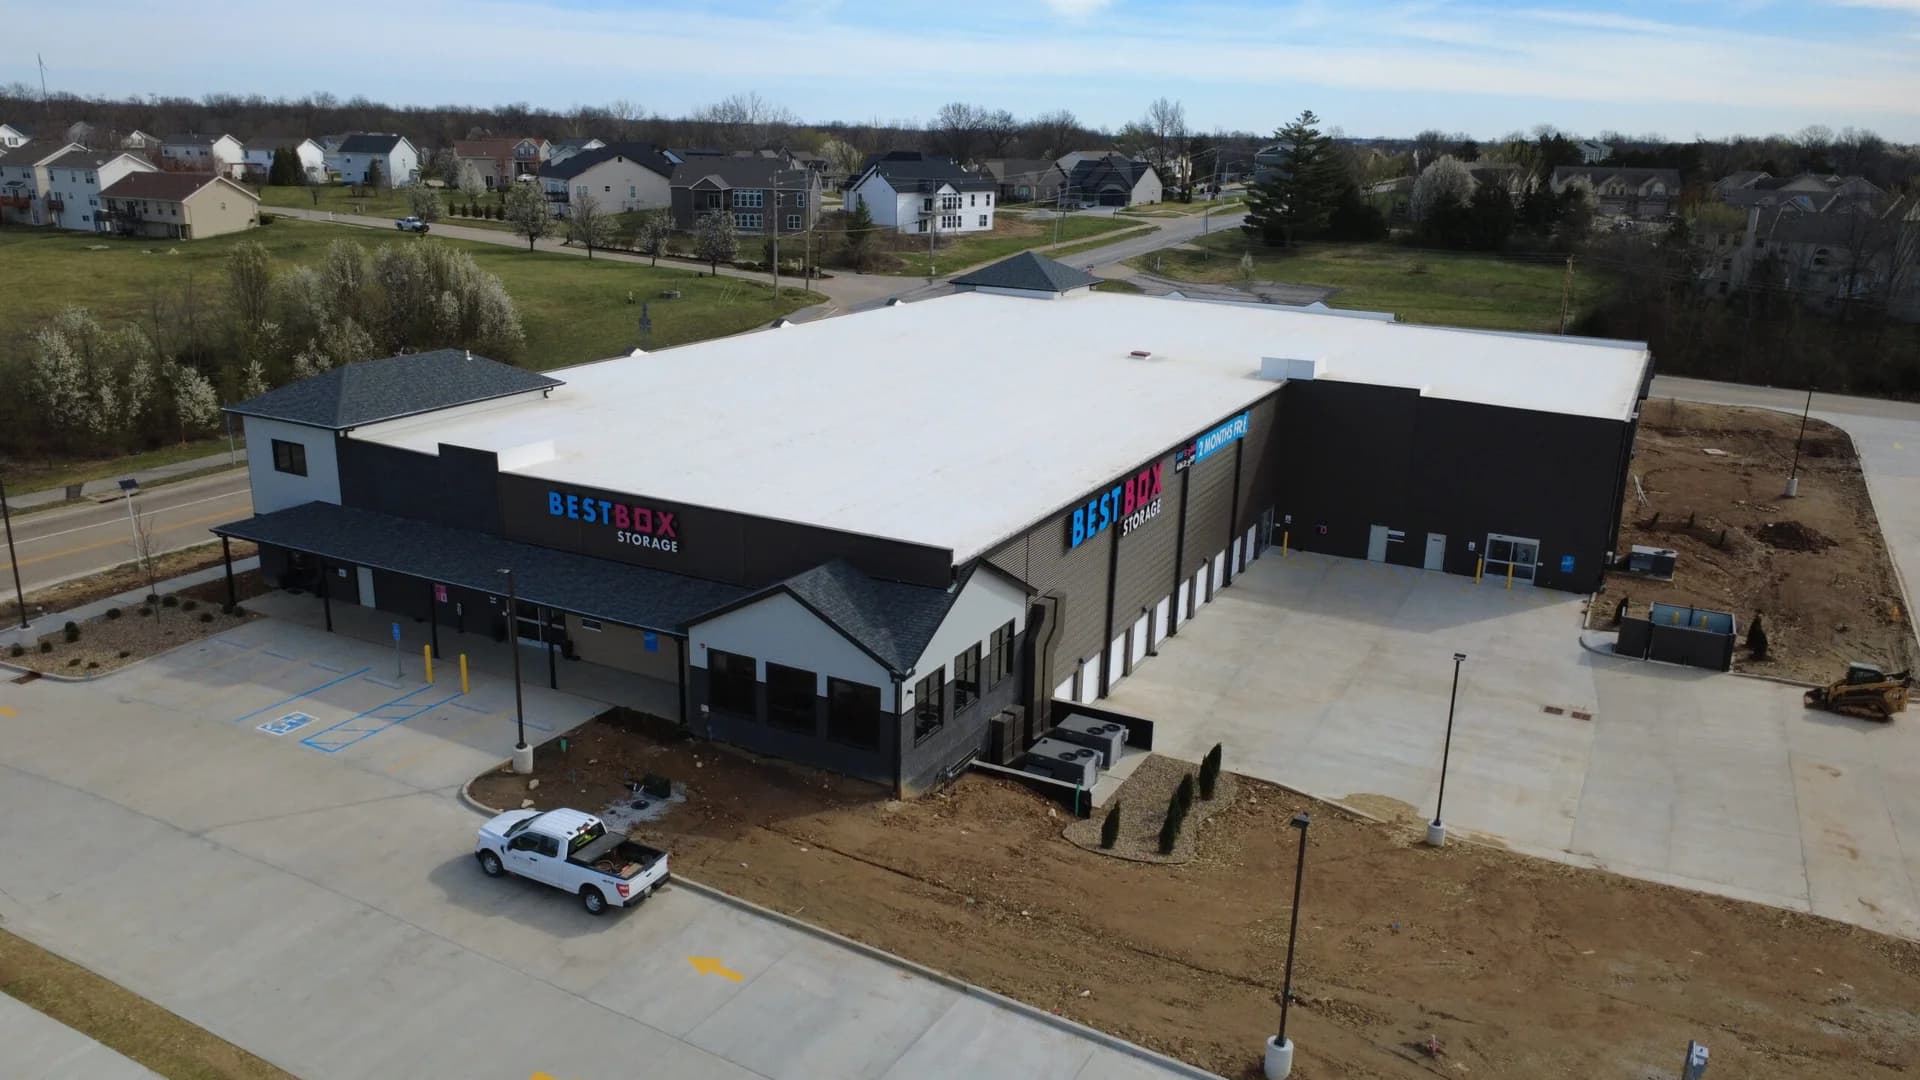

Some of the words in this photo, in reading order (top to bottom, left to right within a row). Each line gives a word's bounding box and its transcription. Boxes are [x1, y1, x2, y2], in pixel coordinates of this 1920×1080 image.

[1199, 441, 1204, 457] 2
[1204, 424, 1233, 454] MONTHS
[1123, 499, 1161, 536] STORAGE
[617, 531, 678, 552] STORAGE
